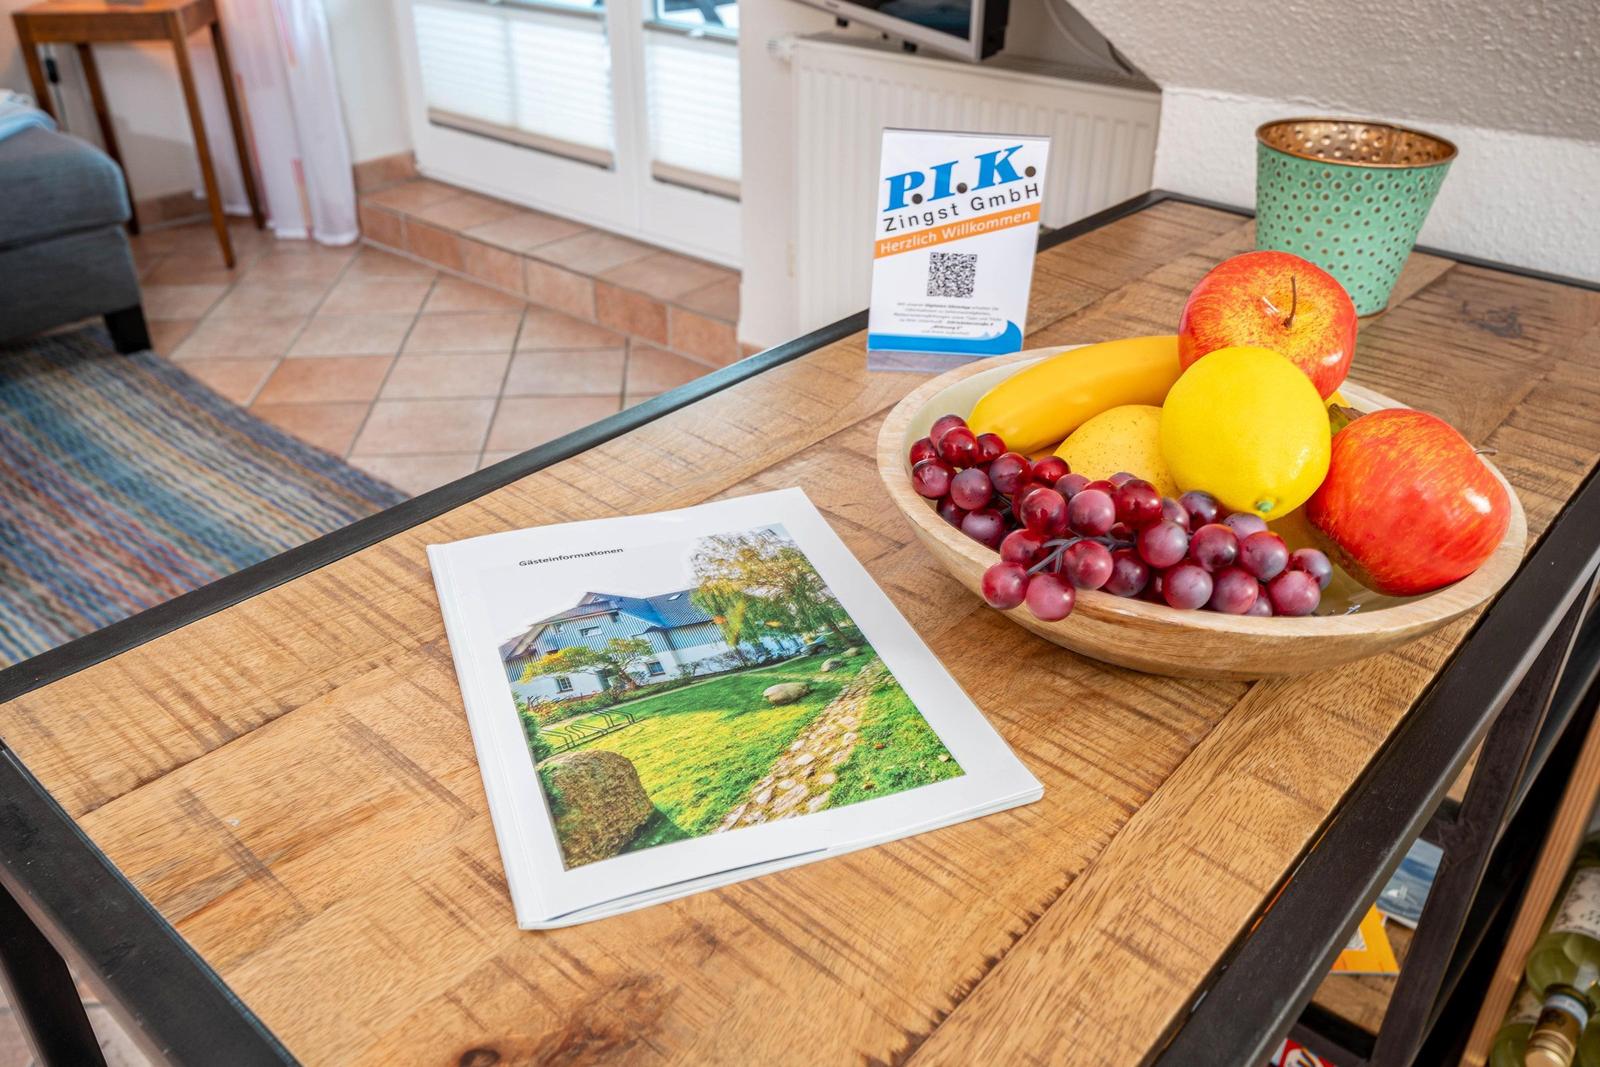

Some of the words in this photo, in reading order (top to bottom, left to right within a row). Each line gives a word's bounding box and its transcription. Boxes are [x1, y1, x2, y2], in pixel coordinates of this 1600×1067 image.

[883, 145, 1036, 212] P.I.K.
[883, 204, 959, 232] Zingst
[971, 183, 1040, 211] GmbH
[880, 232, 937, 254] Herzlich
[942, 210, 1031, 240] Willkommen
[519, 548, 624, 567] Gästeinformationen
